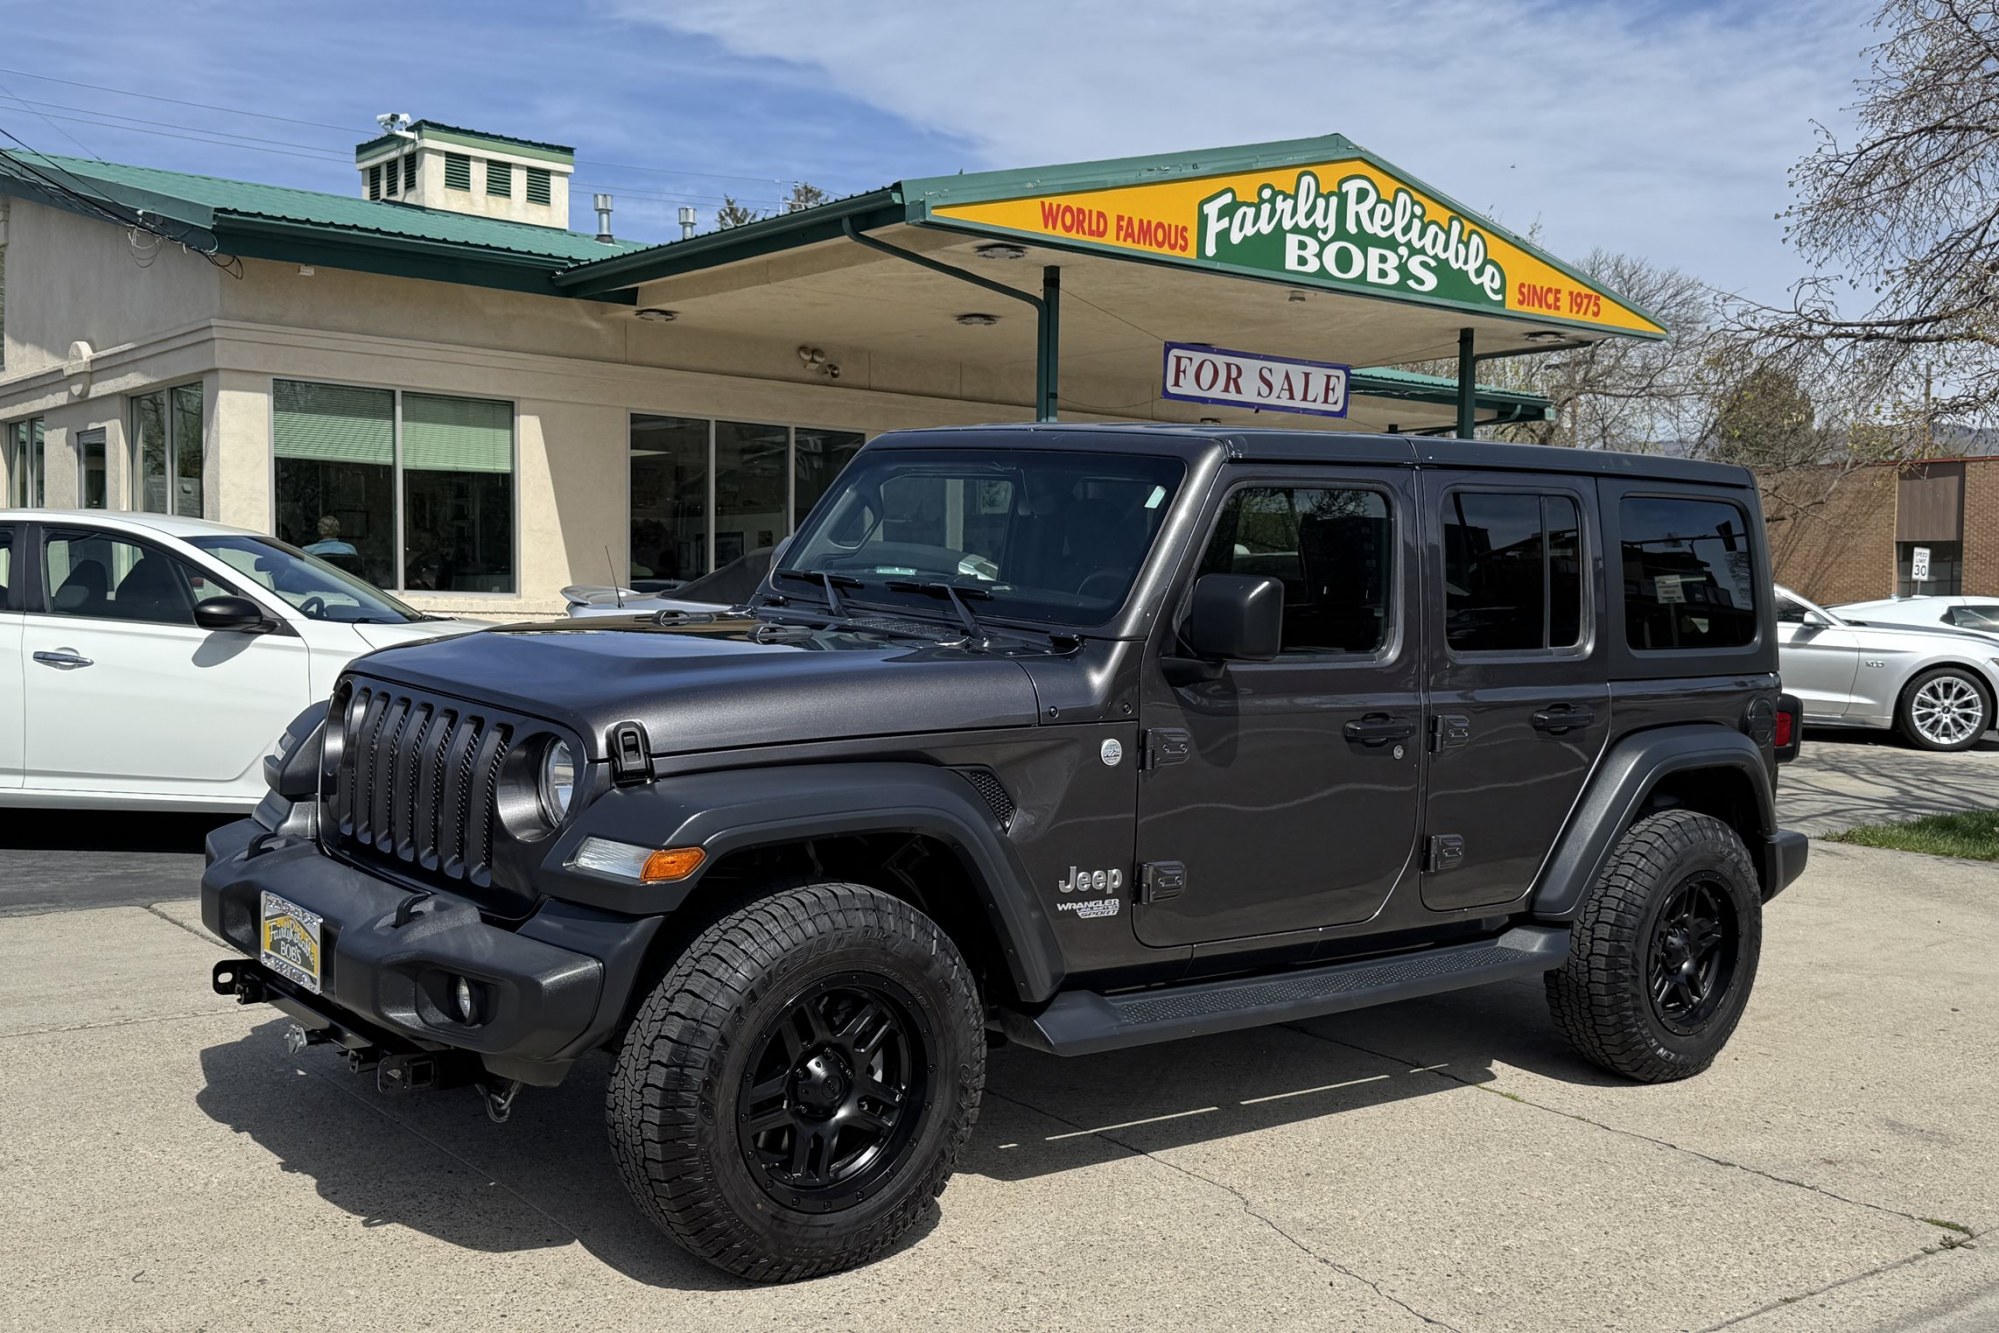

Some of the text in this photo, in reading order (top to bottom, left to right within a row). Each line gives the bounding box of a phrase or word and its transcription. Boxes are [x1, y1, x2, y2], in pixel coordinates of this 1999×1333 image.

[1040, 200, 1189, 253] WORLD FAMOUS
[1203, 175, 1503, 301] Fairly Reliable
[1285, 232, 1438, 292] BOB'S
[1517, 282, 1601, 318] SINCE 1975
[1171, 355, 1341, 406] FOR SALE
[1914, 564, 1927, 576] 30
[1058, 866, 1122, 894] Jeep
[1057, 899, 1119, 911] WRANGLER
